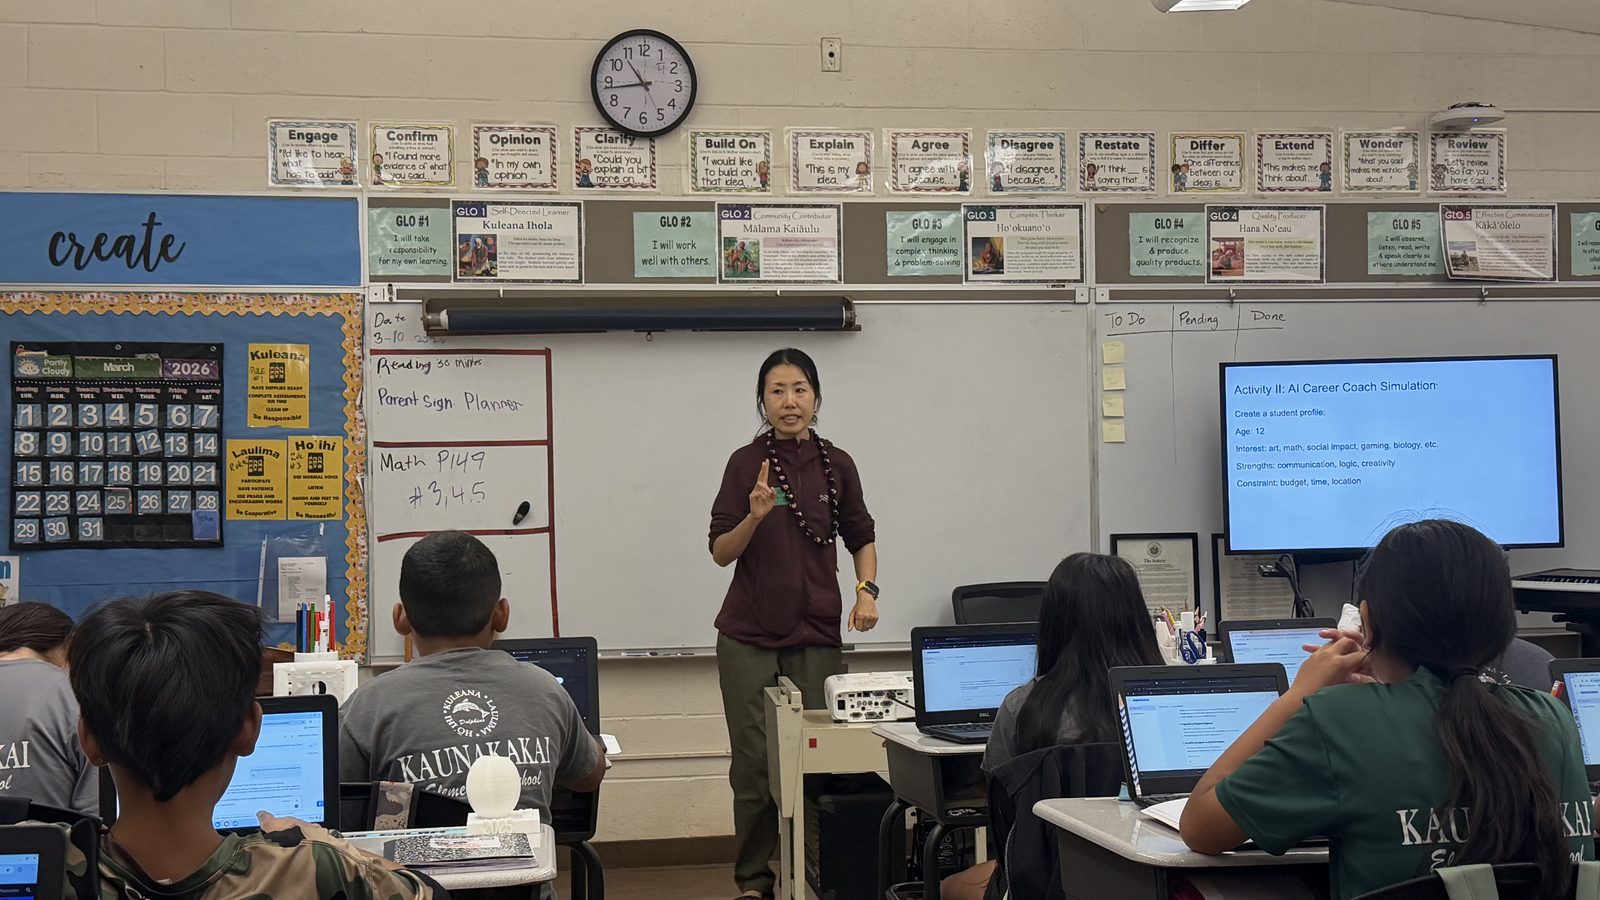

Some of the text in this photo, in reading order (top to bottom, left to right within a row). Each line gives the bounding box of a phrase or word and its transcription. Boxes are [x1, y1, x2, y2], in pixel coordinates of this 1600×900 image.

[623, 47, 632, 59] 11
[638, 45, 650, 57] 12
[658, 49, 662, 61] 1
[609, 59, 623, 71] 10
[670, 62, 678, 74] 2
[605, 76, 613, 88] 9
[674, 80, 682, 92] 3
[610, 94, 618, 107] 8
[668, 98, 676, 110] 4
[623, 107, 631, 119] 7
[639, 112, 647, 124] 6
[657, 108, 665, 121] 5
[288, 130, 338, 142] Engage
[387, 131, 438, 142] Confirm
[489, 134, 541, 146] Opinion
[706, 139, 756, 149] Build On
[810, 139, 854, 151] Explain
[912, 140, 949, 152] Agree
[1001, 140, 1053, 151] Disagree
[1095, 140, 1140, 150] Restate
[1190, 141, 1225, 150] Differ
[1275, 141, 1314, 150] Extend
[1360, 139, 1403, 149] Wonder
[1448, 140, 1488, 149] Review
[457, 208, 486, 216] GLO 1
[721, 210, 750, 219] GLO 2
[967, 211, 995, 220] GLO 3
[1210, 212, 1238, 221] GLO 4
[1445, 211, 1471, 219] GLO 5
[396, 216, 429, 227] GLO #1
[483, 221, 553, 230] Kuleana Ihola
[660, 216, 691, 227] GLO #2
[912, 219, 942, 229] GLO #3
[1155, 218, 1183, 229] GLO #4
[1393, 219, 1421, 230] GLO #5
[743, 224, 781, 233] Mālama
[1239, 225, 1260, 233] Hana
[49, 211, 186, 272] create
[660, 240, 673, 249] will
[676, 240, 696, 249] work
[1161, 237, 1199, 245] recognize
[389, 246, 437, 255] responsibility
[1149, 247, 1189, 256] & produce
[379, 257, 390, 265] for
[392, 259, 402, 267] my
[419, 257, 448, 267] learning.
[642, 256, 710, 265] well with others.
[1136, 258, 1202, 267] quality products.
[374, 313, 406, 328] Date
[1105, 312, 1145, 327] To Do
[1180, 312, 1218, 330] Pending
[1251, 311, 1286, 322] Done
[250, 350, 305, 361] Kuleana
[44, 360, 68, 368] Partly
[104, 363, 134, 372] March
[172, 363, 210, 375] 2026
[377, 357, 431, 375] Reading
[42, 368, 70, 376] Cloudy
[1235, 385, 1271, 396] Activity
[1303, 384, 1339, 393] Career
[1343, 383, 1377, 392] Coach
[1380, 381, 1436, 391] Simulation
[378, 388, 419, 406] Parent
[21, 405, 33, 425] 1
[52, 405, 67, 425] 2
[83, 405, 98, 425] 3
[109, 406, 126, 424] 4
[139, 405, 154, 425] 5
[171, 406, 187, 425] 6
[198, 406, 213, 425] 7
[1300, 409, 1326, 418] profile:
[1235, 428, 1253, 436] Age:
[1331, 443, 1358, 452] impact,
[1361, 443, 1391, 451] gaming,
[1394, 441, 1422, 450] biology,
[232, 446, 280, 459] Laulima
[381, 453, 426, 472] Math
[1237, 462, 1275, 470] Strengths:
[1277, 461, 1337, 469] communication,
[1361, 459, 1395, 468] creativity
[1280, 479, 1309, 488] budget,
[17, 524, 35, 537] 29
[47, 522, 65, 536] 30
[82, 522, 100, 536] 31
[443, 690, 481, 710] KULEANA
[480, 700, 498, 735] LAULIMA
